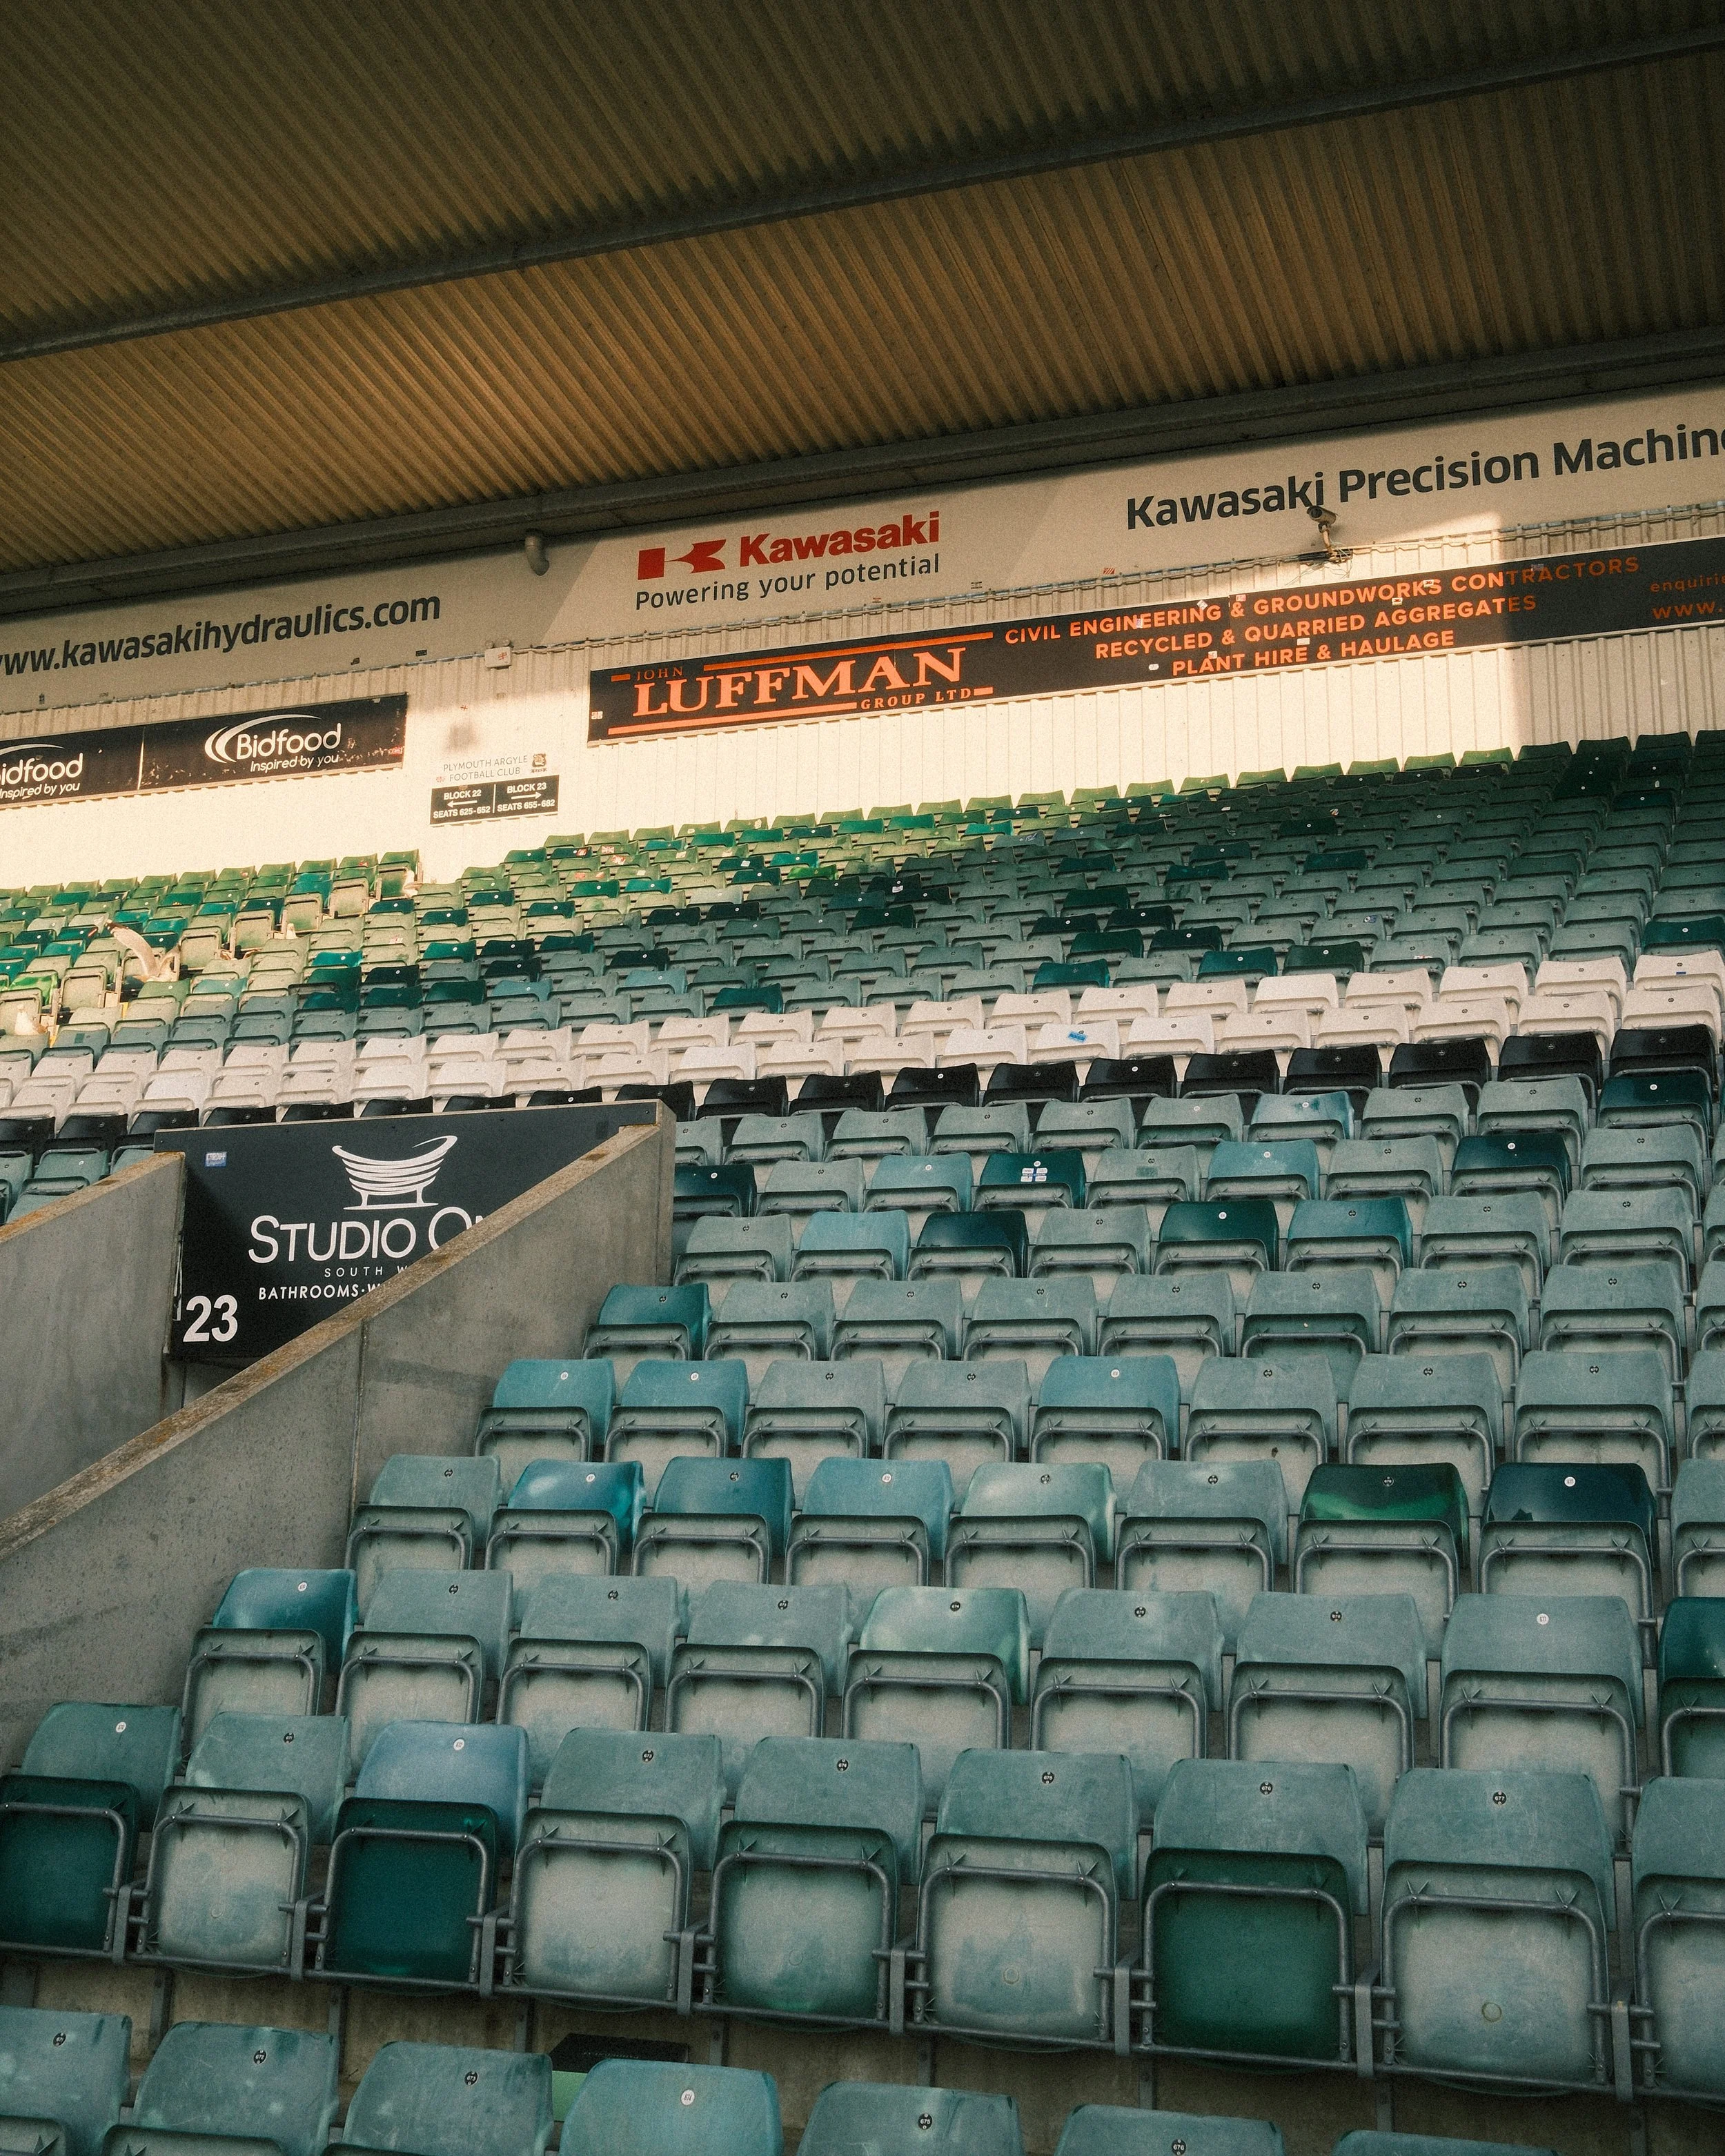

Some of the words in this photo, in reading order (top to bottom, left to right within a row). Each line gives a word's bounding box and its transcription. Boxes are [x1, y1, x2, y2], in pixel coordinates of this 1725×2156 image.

[1127, 471, 1324, 531] Kawasaki
[1339, 451, 1539, 503] Precision
[1553, 424, 1725, 476] Machin
[739, 511, 940, 567] Kawasaki
[635, 580, 750, 610] Powering
[758, 568, 816, 598] your
[825, 553, 940, 590] potential
[1004, 624, 1061, 645] CIVIL
[1070, 604, 1222, 637] ENGINEERING
[1230, 602, 1245, 619] &
[1253, 578, 1442, 617] GROUNDWORKS
[1451, 556, 1639, 592] CONTRACTORS
[0, 595, 441, 675] ww.kawasakihydraulics.com
[1095, 631, 1214, 660] RECYCLED
[1221, 630, 1236, 646] &
[1245, 614, 1366, 643] QUARRIED
[1374, 595, 1537, 629] AGGREGATES
[1172, 653, 1246, 677] PLANT
[1254, 646, 1308, 667] HIRE
[1317, 644, 1332, 661] &
[1340, 629, 1455, 658] HAULAGE
[632, 647, 967, 718] LUFFMAN
[636, 666, 684, 681] JOHN
[860, 693, 926, 710] GROUP
[935, 688, 972, 702] LTD
[235, 722, 342, 760] Bidfood
[0, 752, 83, 786] idfood
[250, 756, 299, 773] Inspired
[300, 755, 315, 769] by
[317, 753, 339, 767] you
[443, 759, 492, 772] PLYMOUTH
[493, 755, 529, 766] ARGYLE
[449, 769, 495, 782] FOOTBALL
[497, 767, 521, 777] CLUB
[43, 783, 58, 796] by
[59, 782, 81, 795] you
[443, 790, 471, 800] BLOCK
[471, 789, 482, 798] 22
[506, 783, 535, 793] BLOCK
[536, 782, 547, 791] 23
[433, 808, 458, 819] SEATS
[459, 805, 491, 815] 625-652
[497, 802, 522, 812] SEATS
[248, 1214, 417, 1263] STUDIO
[324, 1266, 384, 1278] SOUTH
[183, 1294, 238, 1342] 23
